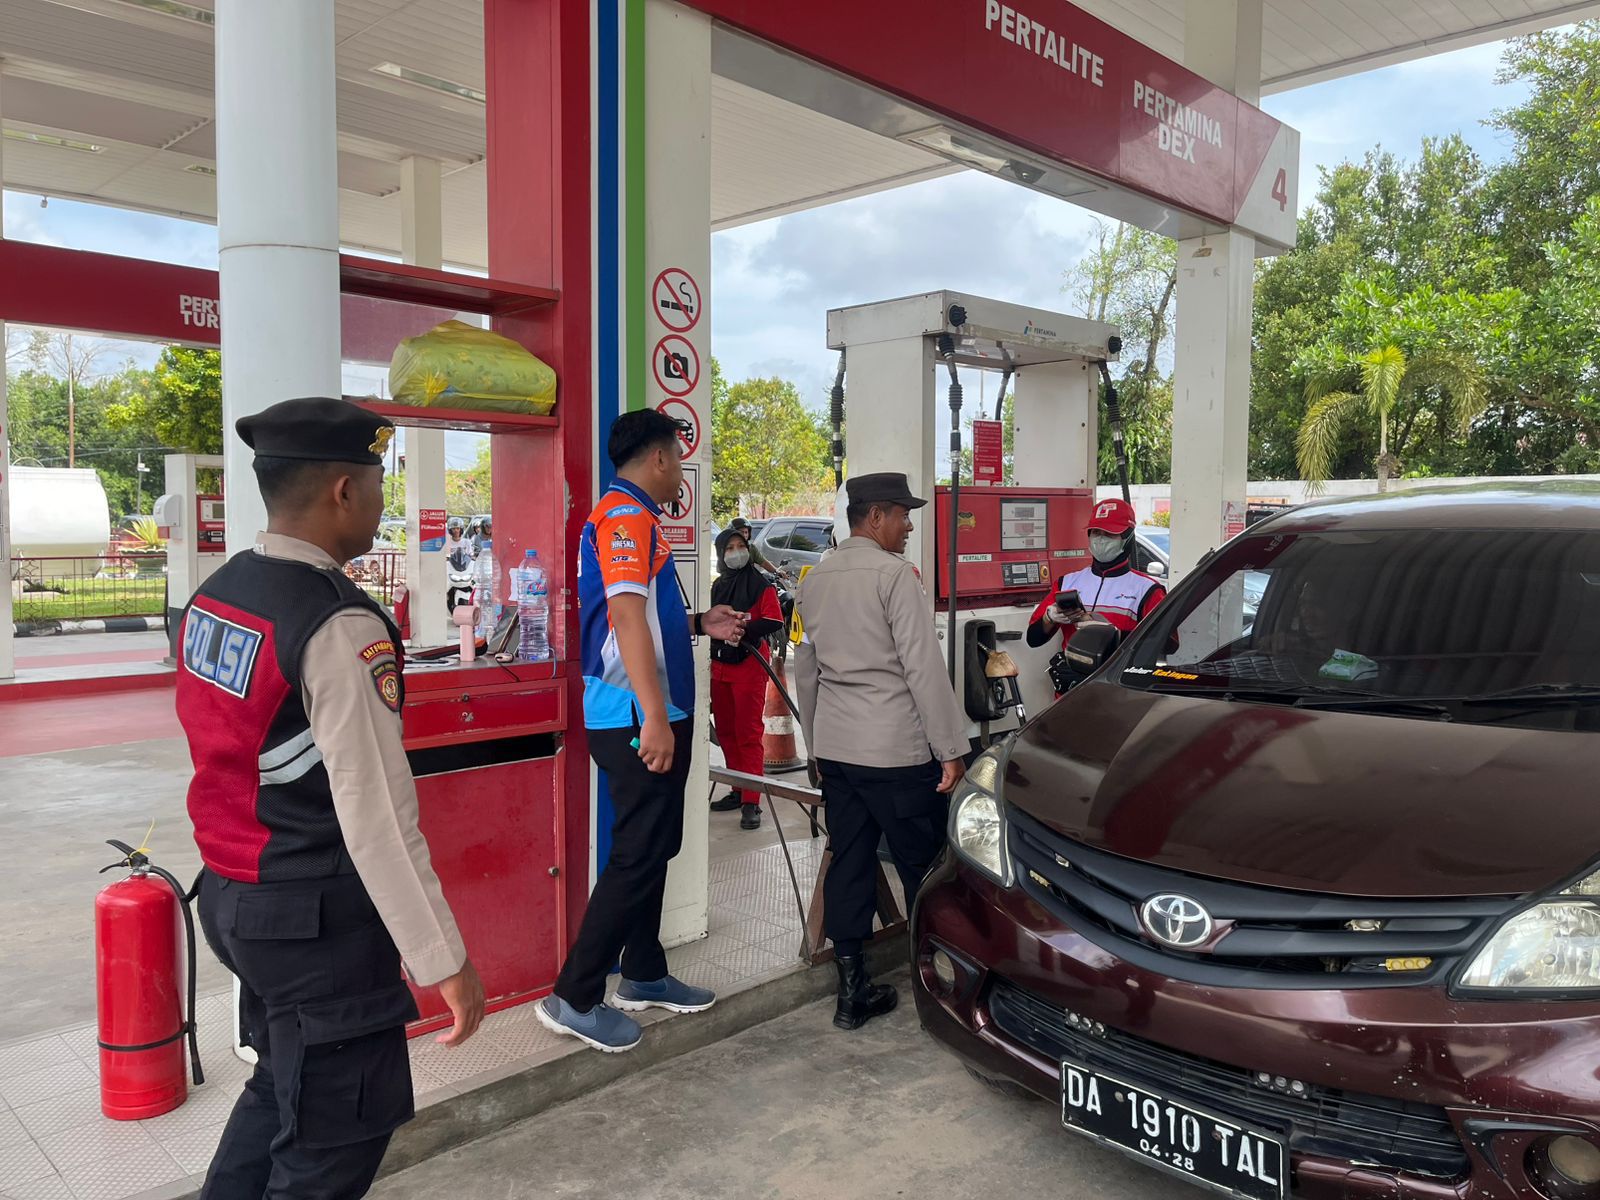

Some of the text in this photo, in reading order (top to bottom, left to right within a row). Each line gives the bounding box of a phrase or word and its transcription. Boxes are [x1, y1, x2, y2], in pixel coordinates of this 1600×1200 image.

[985, 0, 1104, 88] PERTALITE
[1133, 79, 1222, 149] PERTAMINA
[1158, 122, 1196, 165] DEX
[1271, 167, 1288, 212] 4
[1033, 327, 1057, 337] PERTAMINA
[961, 554, 988, 562] PERTALITE
[185, 611, 256, 691] POLISI
[1067, 1068, 1278, 1186] DA 1910 TAL
